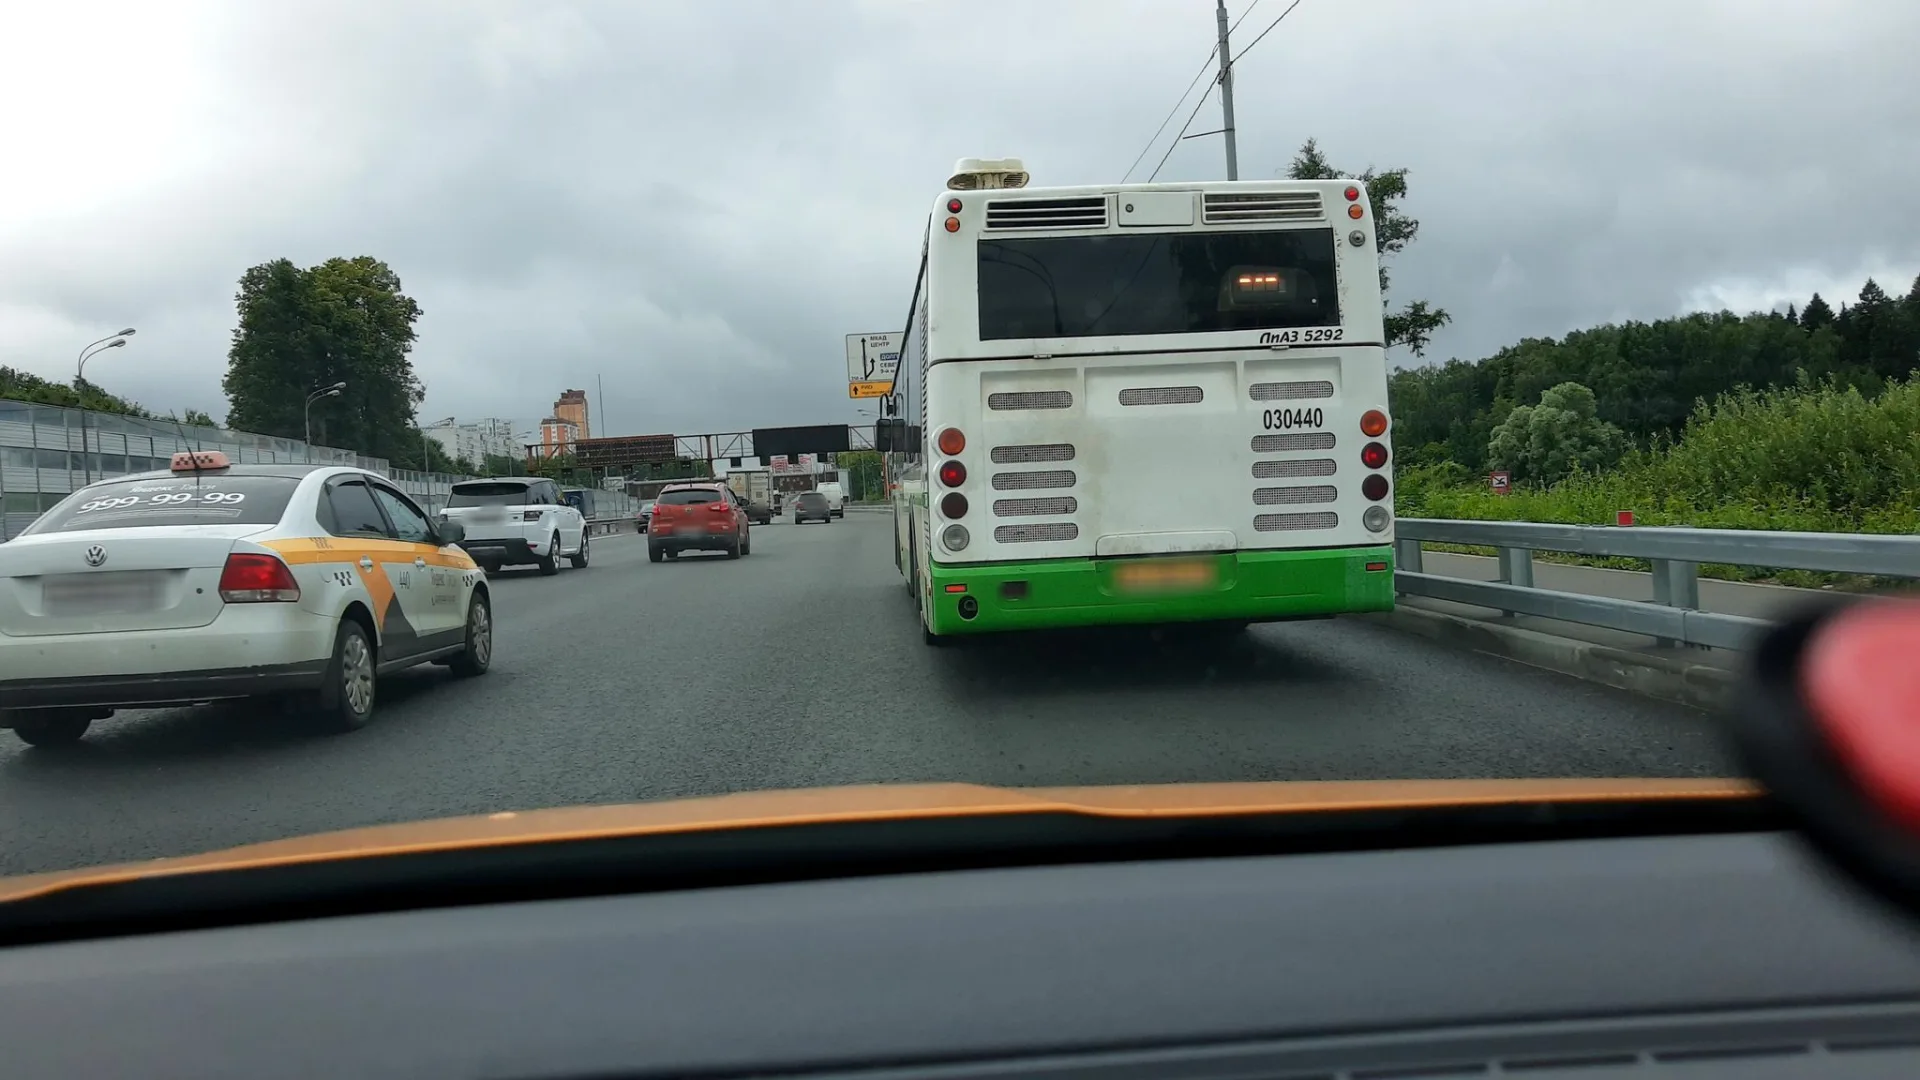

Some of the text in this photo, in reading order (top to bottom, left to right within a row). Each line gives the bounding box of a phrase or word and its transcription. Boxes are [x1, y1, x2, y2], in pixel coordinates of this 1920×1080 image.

[1304, 328, 1343, 342] 5292
[1263, 407, 1323, 430] 030440
[76, 492, 245, 514] 999-99-99
